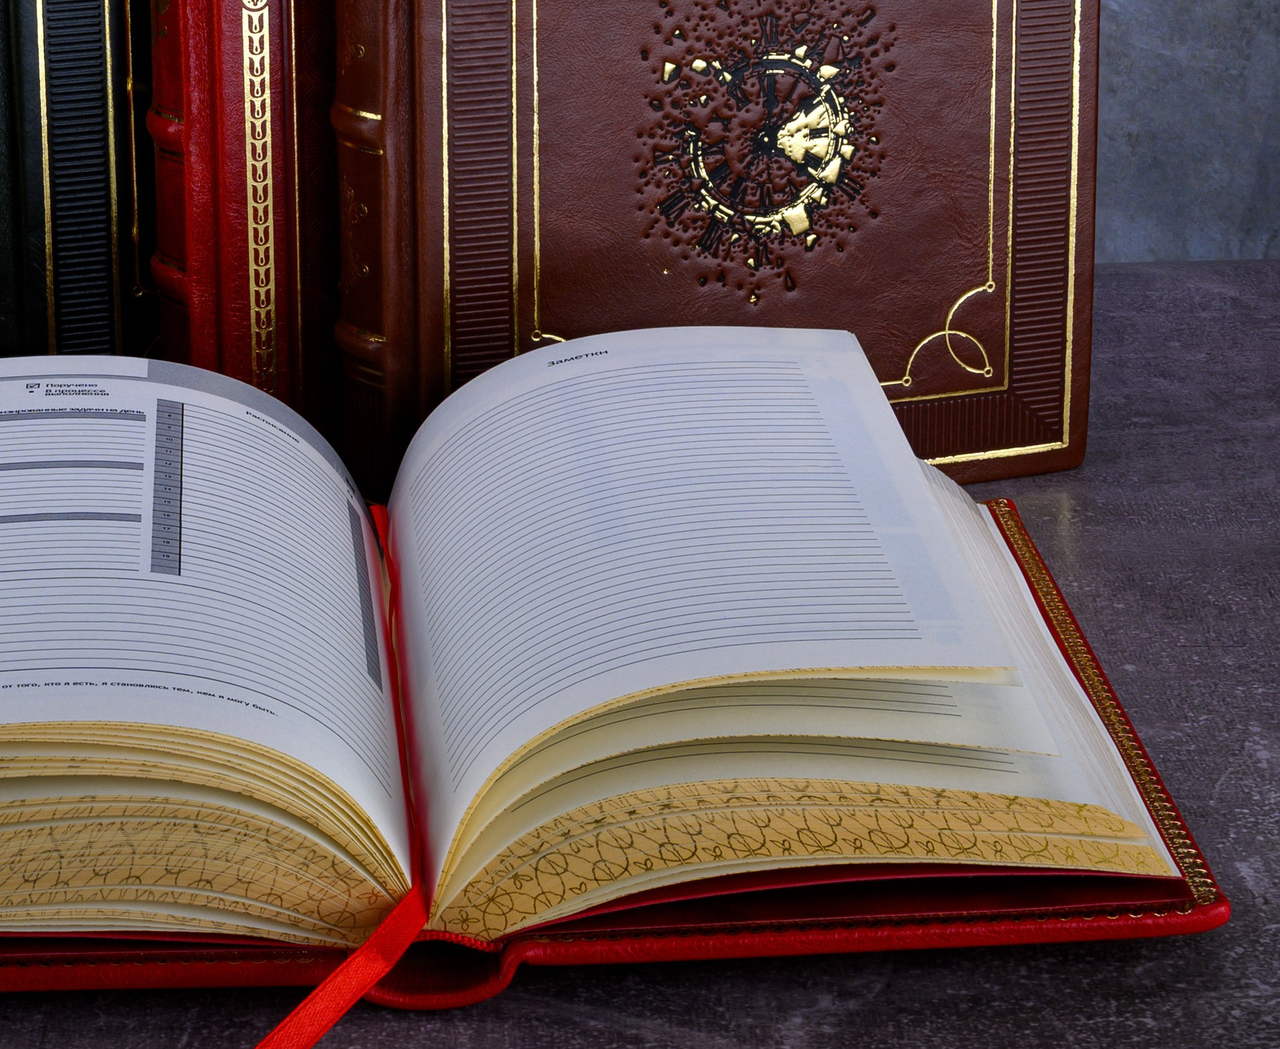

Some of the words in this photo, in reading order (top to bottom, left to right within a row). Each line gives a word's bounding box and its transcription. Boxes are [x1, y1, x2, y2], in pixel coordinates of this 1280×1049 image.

[546, 350, 609, 367] Заметки
[245, 410, 300, 443] Расписание
[110, 681, 169, 690] становлюсь
[172, 686, 194, 694] тем,
[226, 697, 250, 706] могу
[252, 703, 279, 717] быть.
